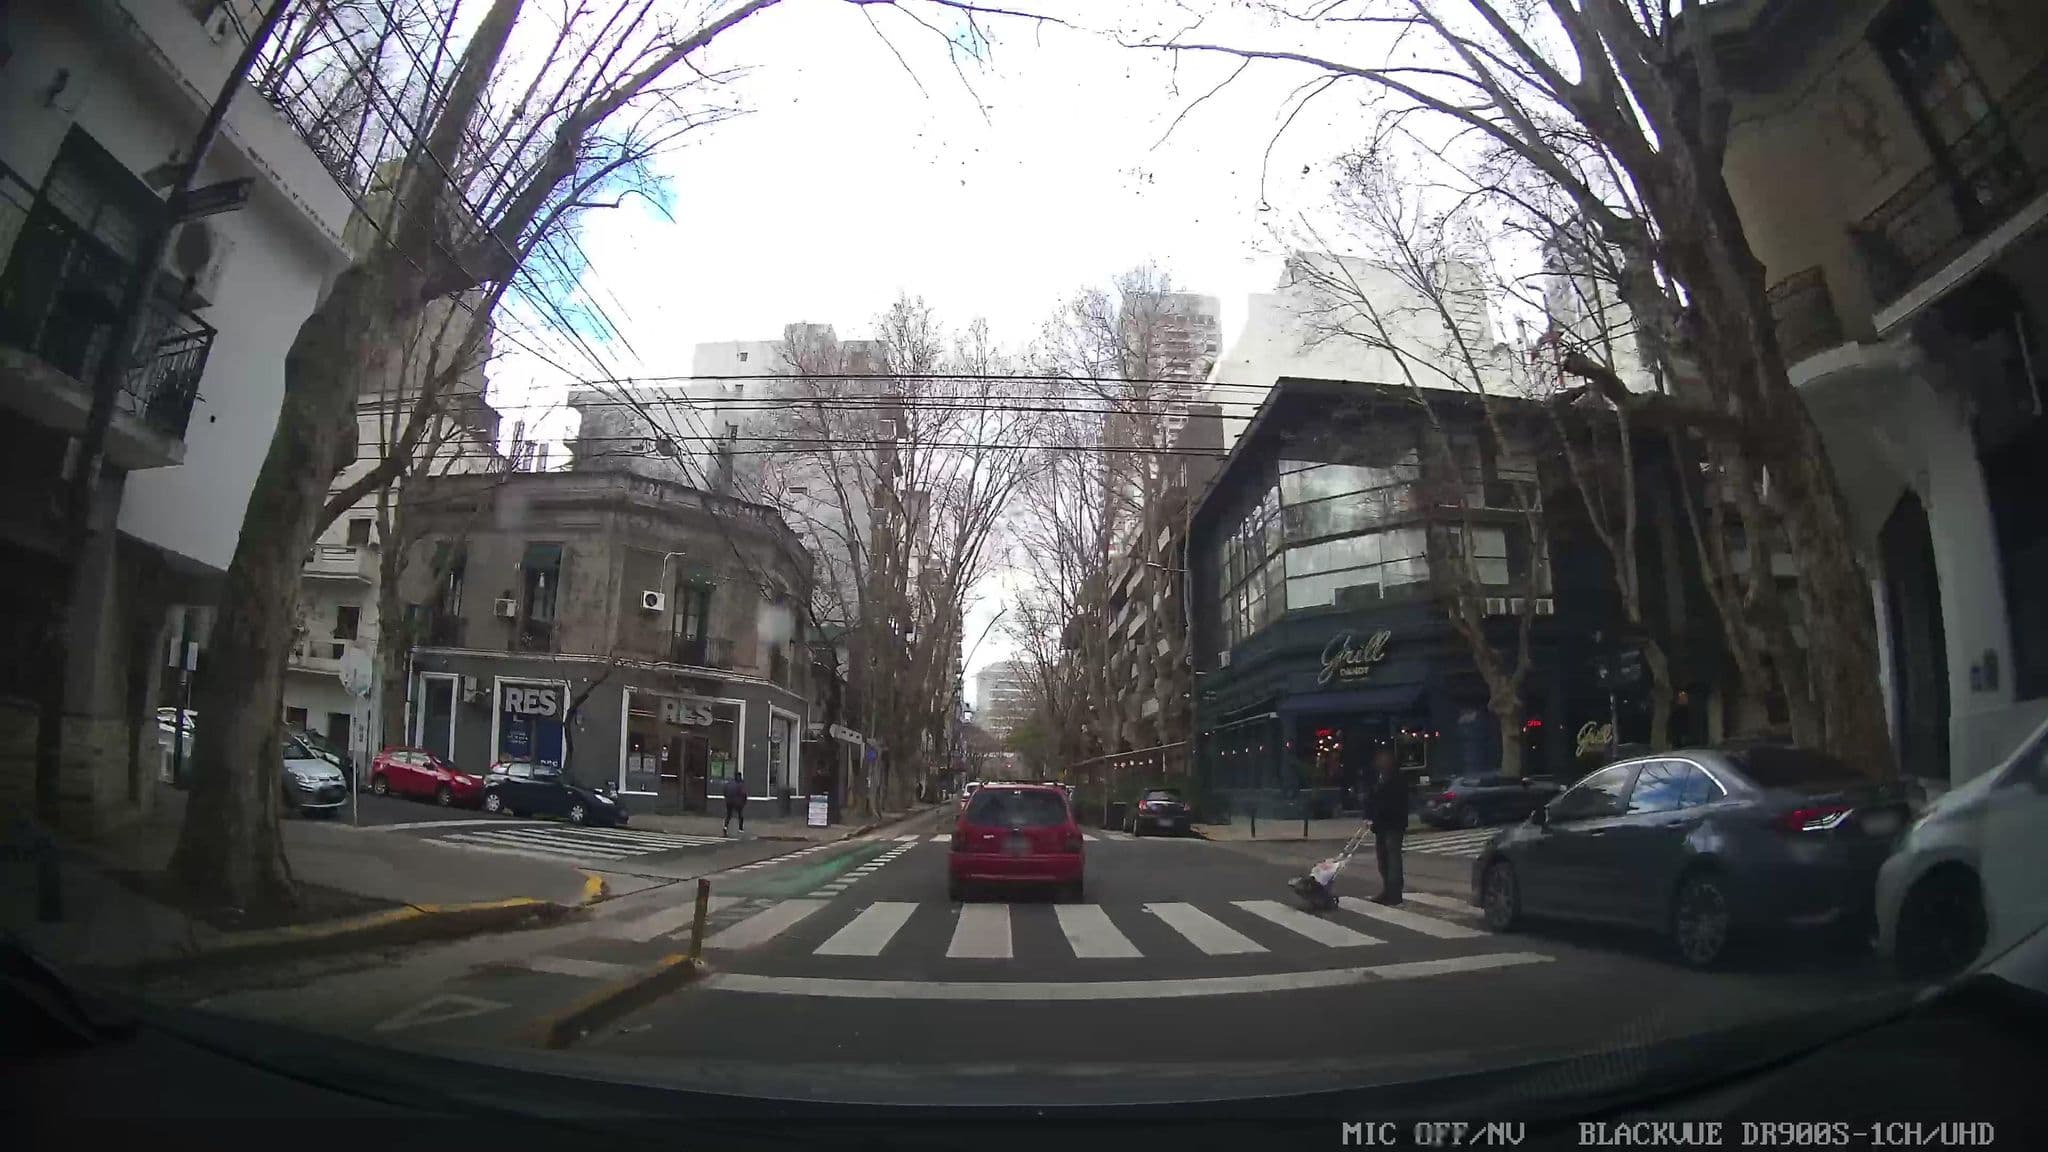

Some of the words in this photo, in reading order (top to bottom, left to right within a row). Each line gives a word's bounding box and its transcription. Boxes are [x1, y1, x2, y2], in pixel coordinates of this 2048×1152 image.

[1318, 630, 1391, 684] Grill
[504, 687, 557, 716] RES
[660, 697, 714, 726] RES
